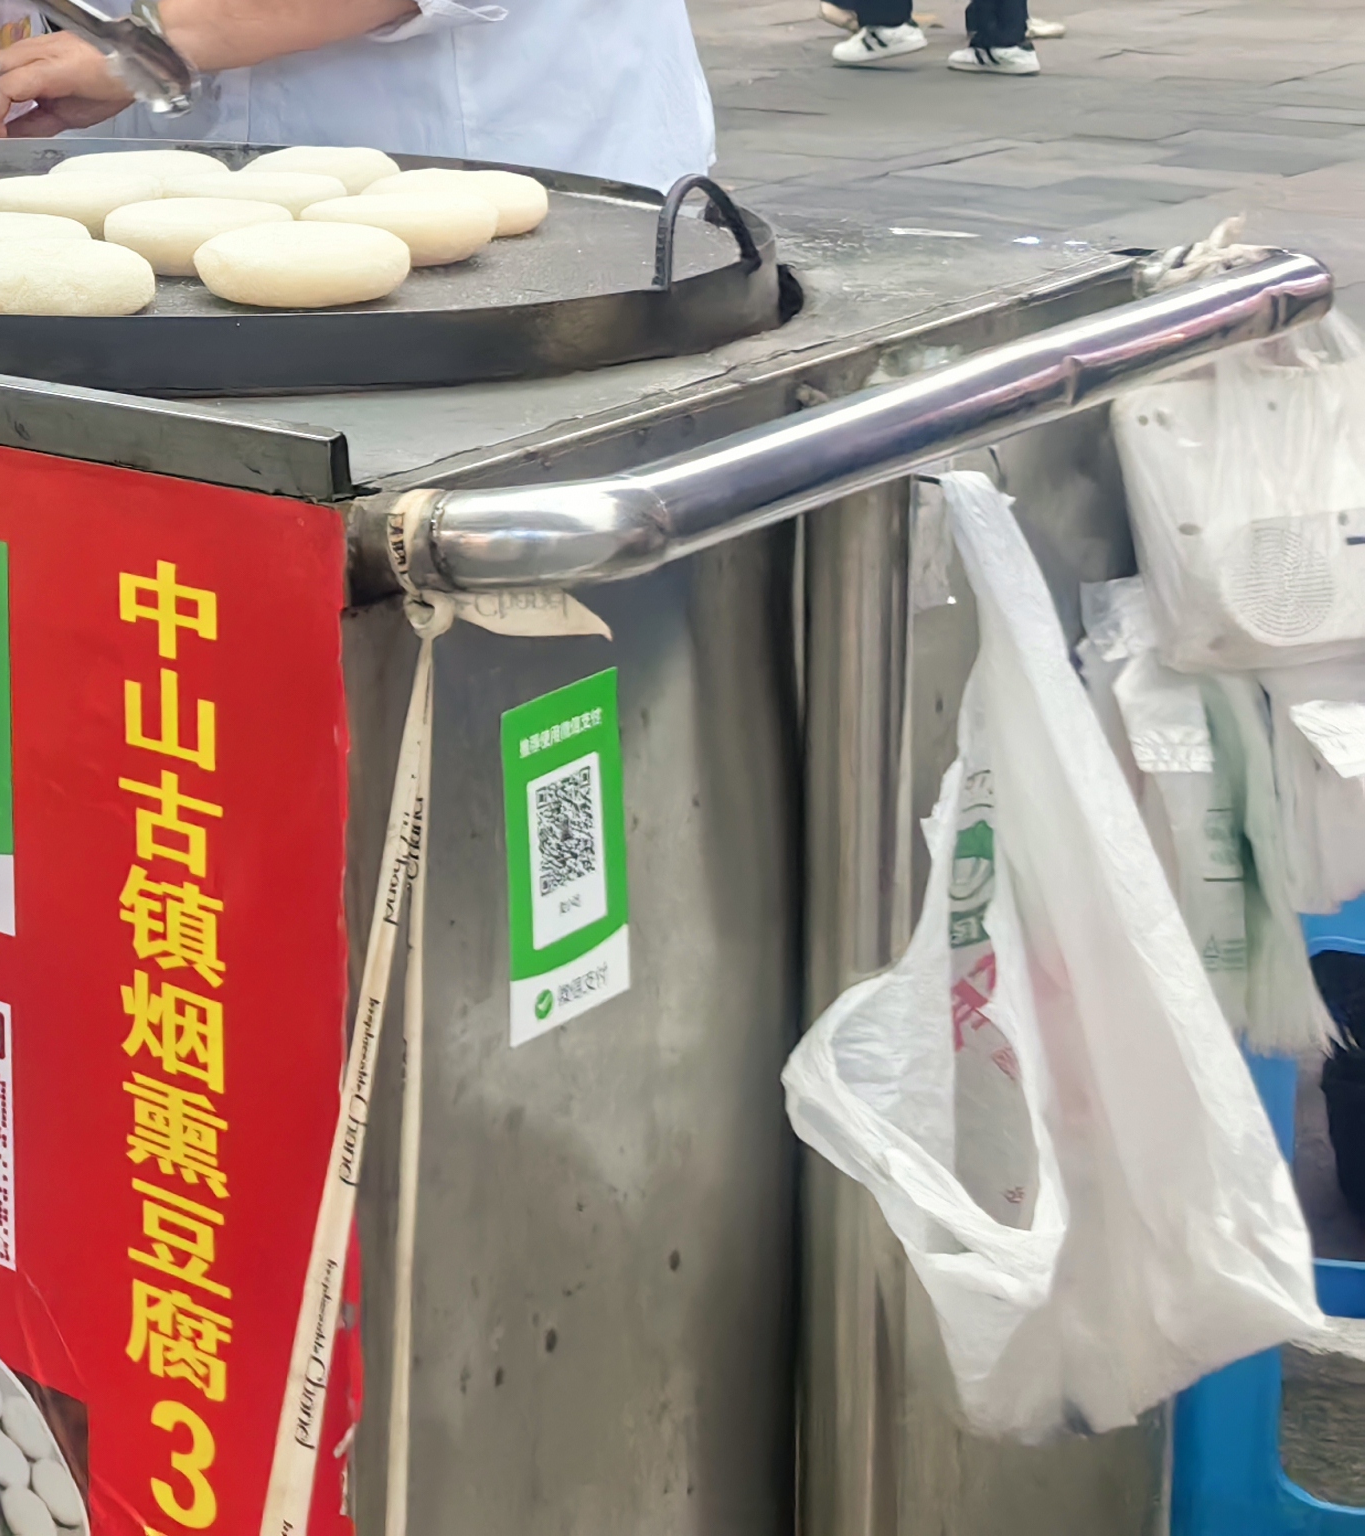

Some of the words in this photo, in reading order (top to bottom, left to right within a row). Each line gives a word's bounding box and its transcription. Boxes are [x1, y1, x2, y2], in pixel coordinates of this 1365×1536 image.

[117, 560, 231, 1536] 中山古镇烟熏豆腐3
